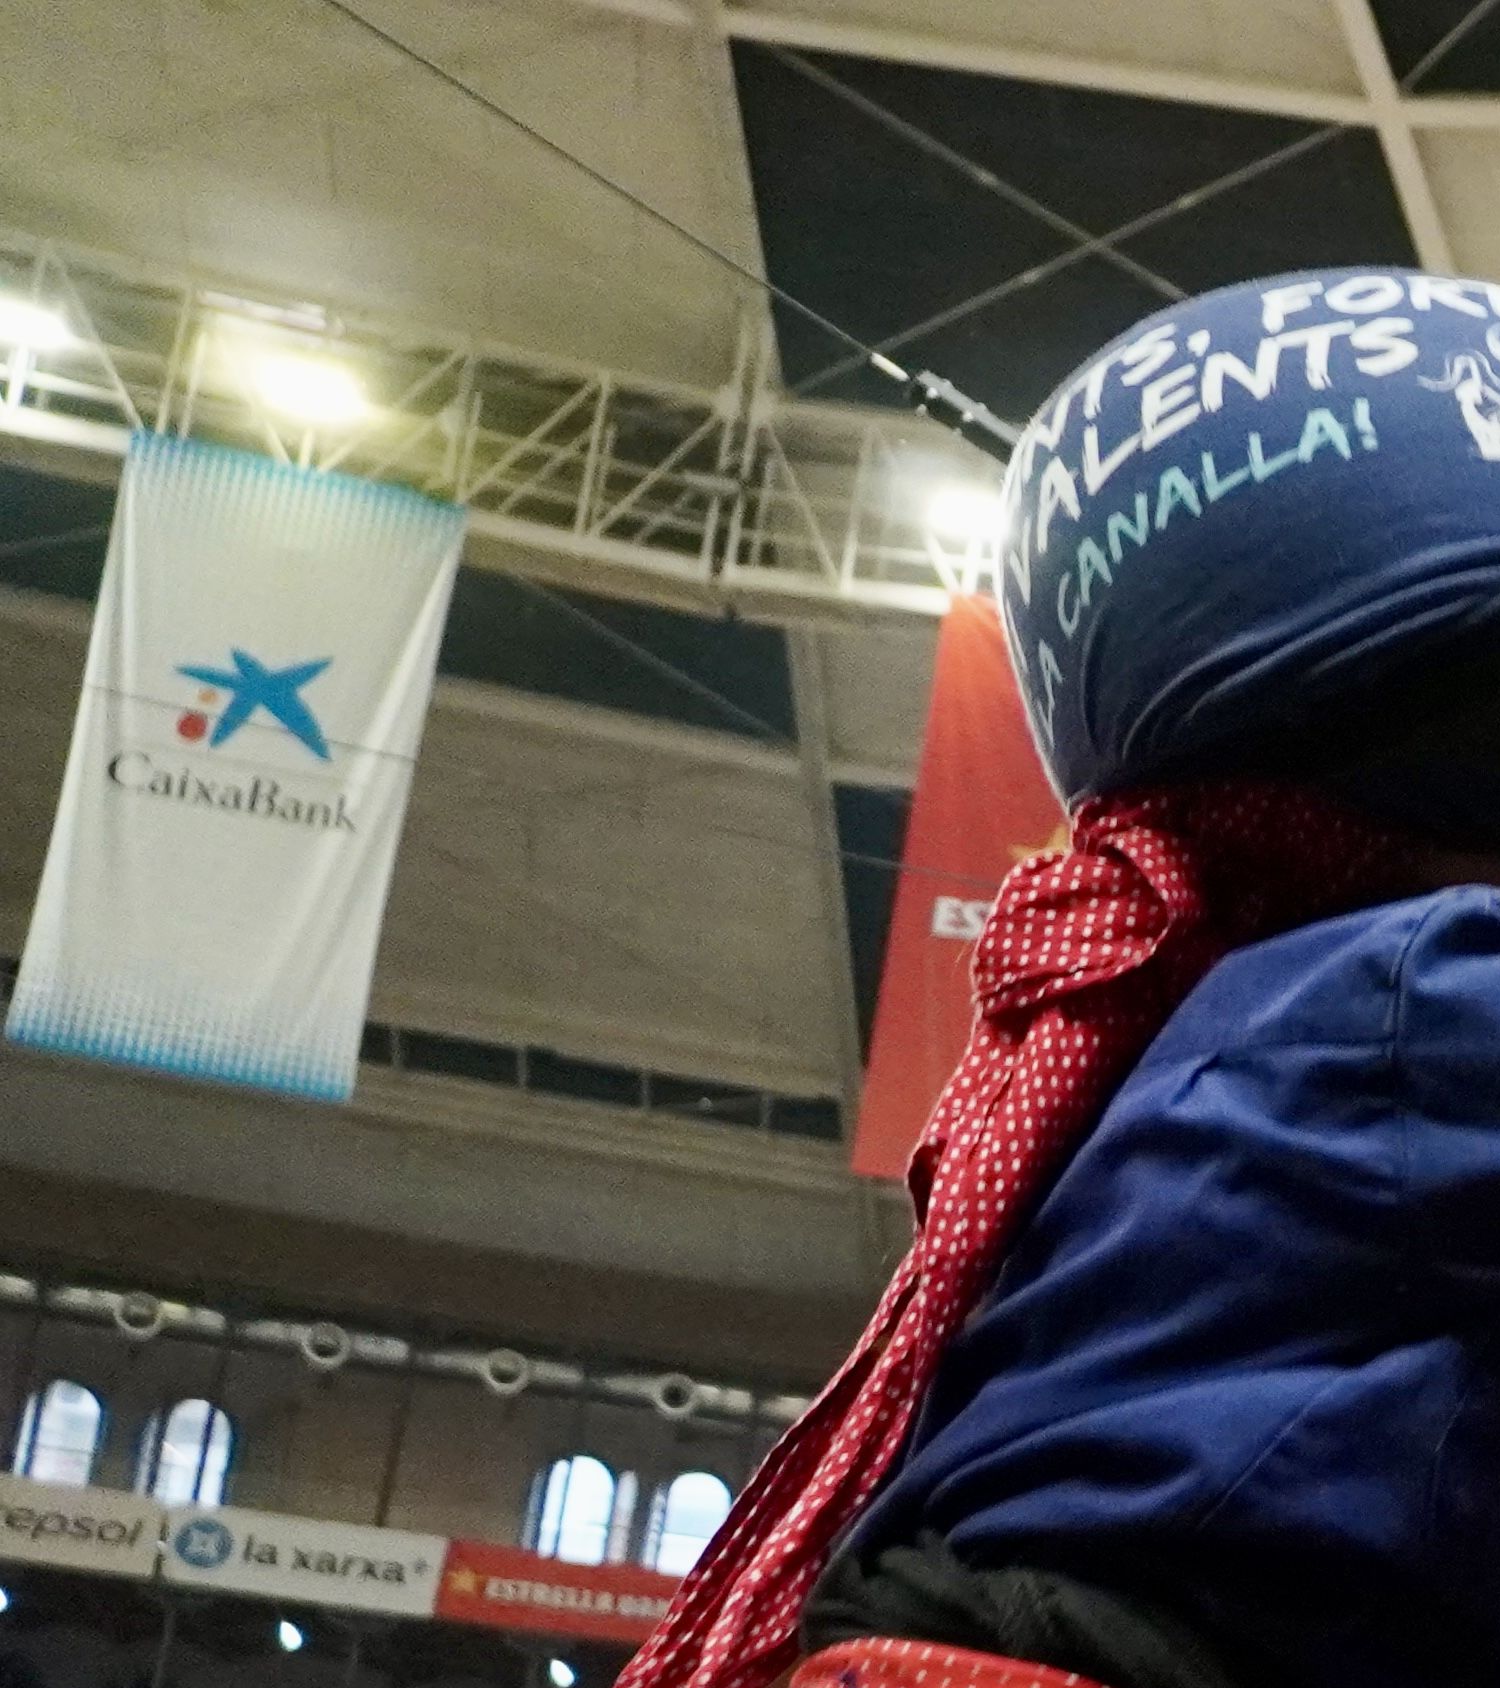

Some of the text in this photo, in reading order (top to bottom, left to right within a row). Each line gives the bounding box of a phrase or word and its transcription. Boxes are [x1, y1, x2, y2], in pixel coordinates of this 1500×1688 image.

[1058, 397, 1378, 638] CANALLA!
[107, 750, 357, 832] CaixaBank
[0, 1505, 142, 1548] epsol
[243, 1536, 278, 1563] la
